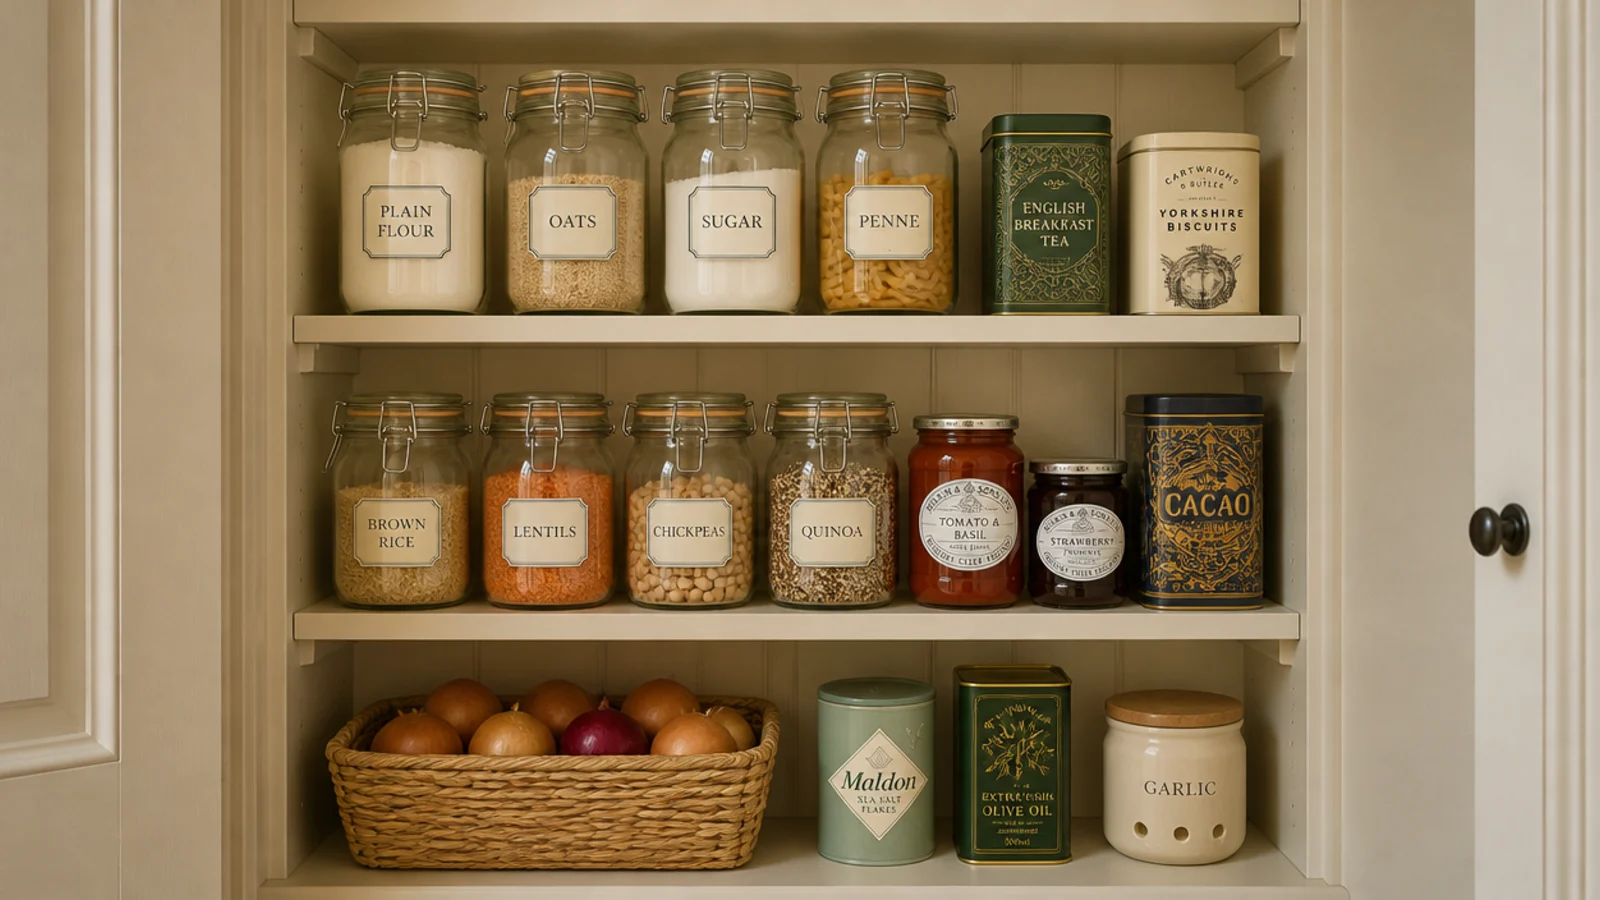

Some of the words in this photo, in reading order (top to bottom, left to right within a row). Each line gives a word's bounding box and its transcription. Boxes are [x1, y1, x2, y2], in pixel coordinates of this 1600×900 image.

[380, 205, 432, 218] PLAIN
[1022, 201, 1086, 215] ENGLISH
[1159, 209, 1245, 218] YORKSHIRE
[548, 214, 597, 229] OATS
[702, 214, 763, 229] SUGAR
[859, 214, 920, 229] PENNE
[1167, 222, 1237, 232] BISCUITS
[377, 224, 435, 238] FLOUR
[1040, 235, 1070, 247] TEA
[1164, 492, 1250, 517] CACAO
[367, 518, 426, 530] BROWN
[939, 517, 989, 527] TOMATO
[513, 526, 577, 538] LENTILS
[653, 526, 726, 538] CHICKPEAS
[801, 525, 864, 541] QUINOA
[954, 530, 987, 540] BASIL
[378, 536, 415, 548] RICE
[841, 770, 916, 791] Maldon
[1143, 780, 1217, 796] GARLIC
[982, 804, 1025, 817] OLIVE
[1028, 804, 1053, 817] OIL
